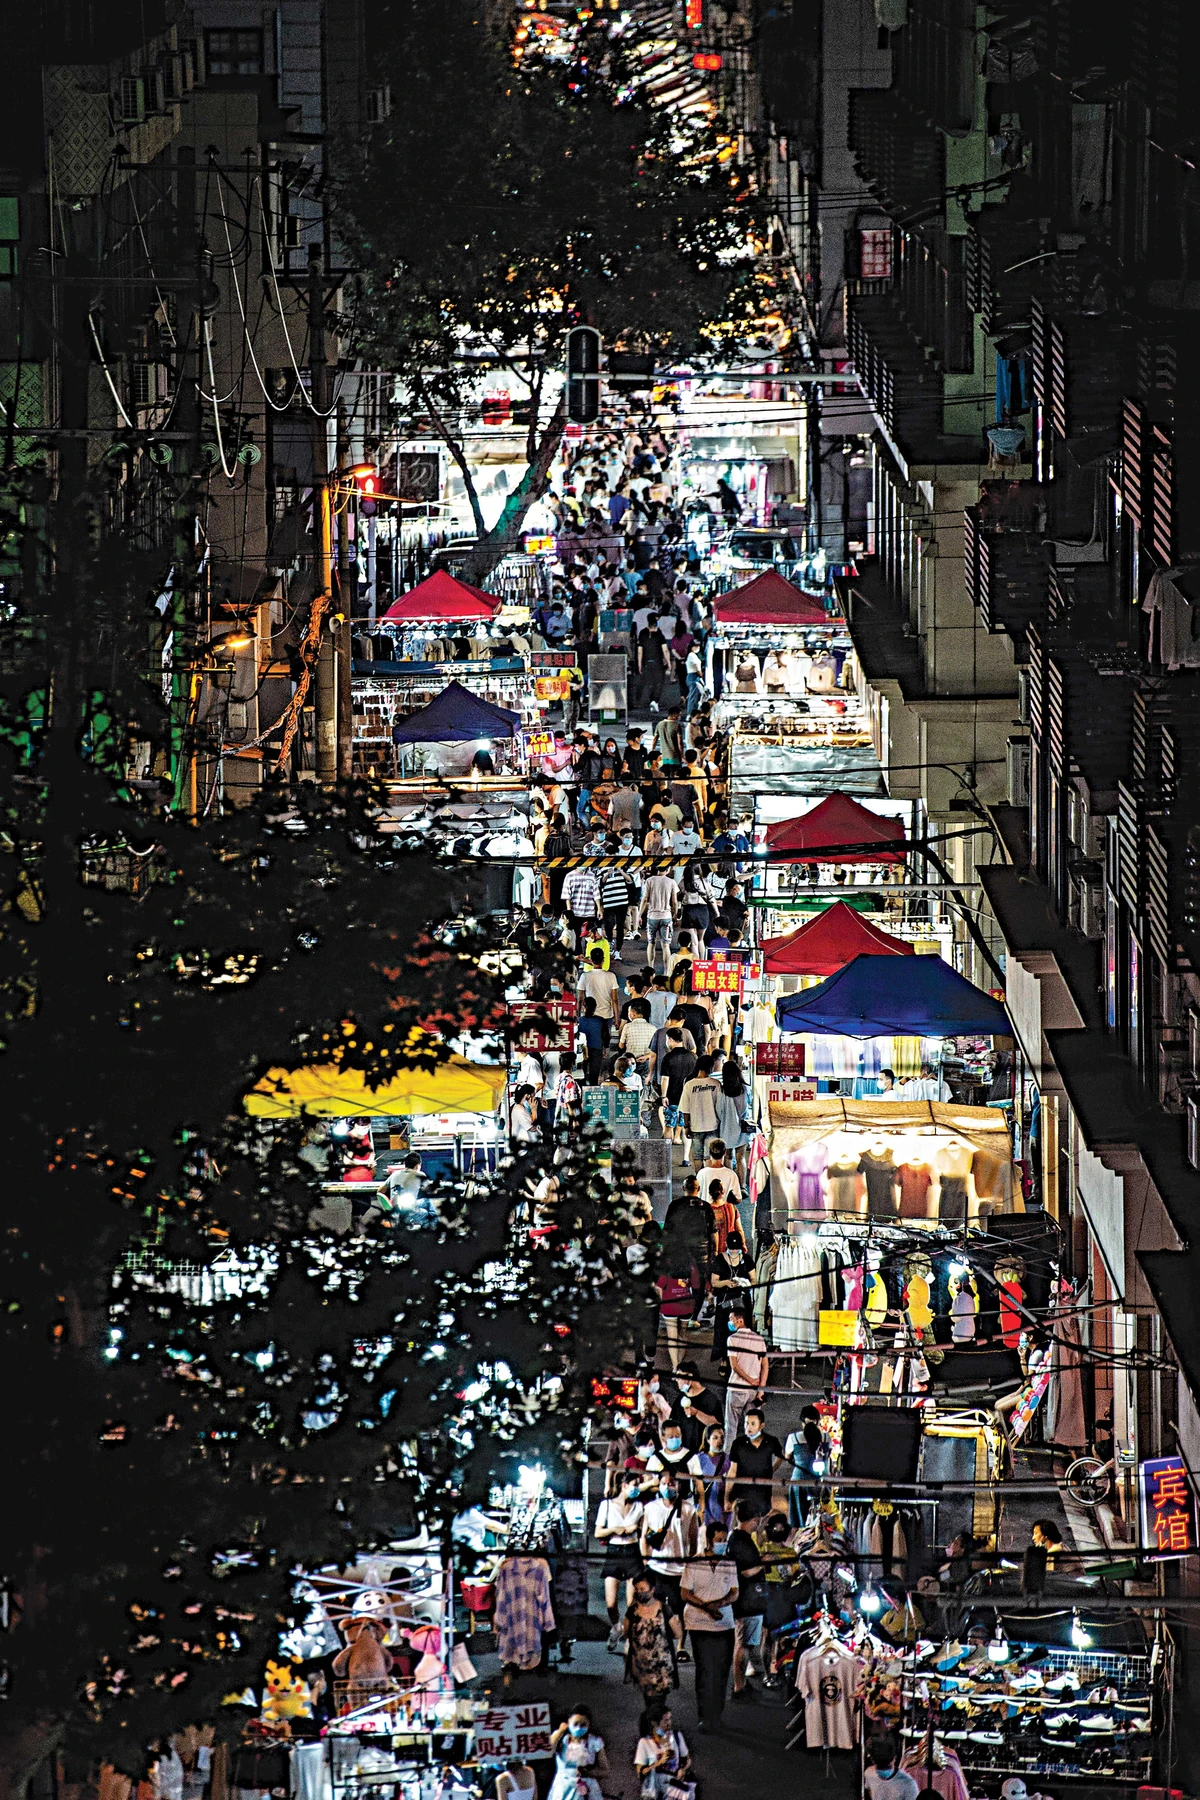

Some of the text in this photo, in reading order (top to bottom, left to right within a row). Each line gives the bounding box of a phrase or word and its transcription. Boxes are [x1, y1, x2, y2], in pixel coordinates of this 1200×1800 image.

[695, 971, 739, 990] 精品女装
[1152, 1464, 1190, 1551] 宾馆
[474, 1708, 550, 1731] 专业
[477, 1731, 552, 1758] 贴膜
